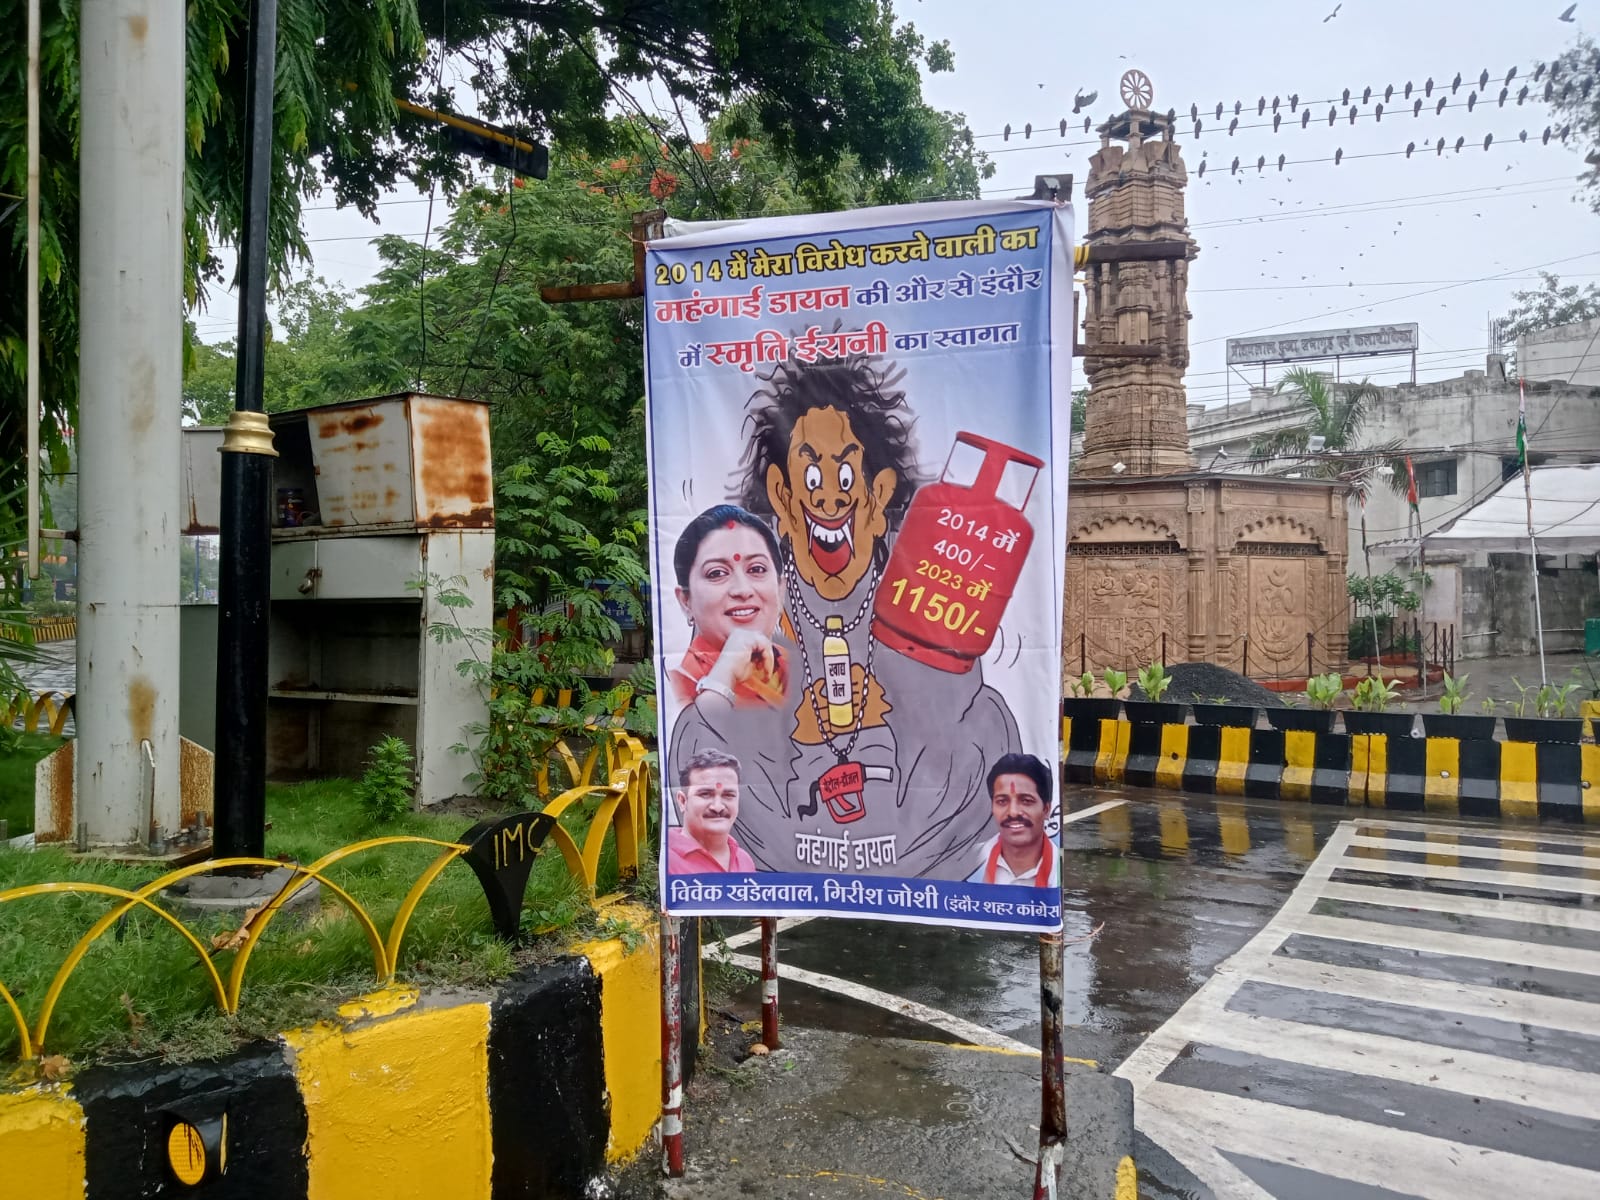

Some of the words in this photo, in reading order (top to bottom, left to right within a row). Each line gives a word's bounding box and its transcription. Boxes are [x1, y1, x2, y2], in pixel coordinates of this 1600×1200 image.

[655, 261, 722, 286] 2014
[728, 249, 748, 279] में
[751, 247, 793, 277] मेरा
[795, 239, 867, 273] विरोध
[870, 229, 930, 265] करने
[934, 224, 996, 258] वाली
[1000, 226, 1040, 251] का
[655, 286, 764, 323] महंगाई
[768, 286, 850, 314] डायन
[856, 280, 890, 306] की
[950, 271, 975, 297] से
[980, 265, 1041, 295] इंदौर
[678, 343, 702, 368] में
[705, 329, 789, 373] स्मृति
[795, 321, 888, 358] ईरानी
[894, 332, 928, 351] का
[933, 323, 1020, 348] स्वागत
[936, 508, 990, 542] 2014
[992, 528, 1021, 554] में
[933, 539, 996, 572] 400/-
[916, 559, 962, 590] 2023
[966, 579, 993, 602] में
[892, 578, 987, 636] 1150/-
[828, 662, 846, 677] खाद्य
[832, 681, 846, 698] तेल
[494, 817, 542, 870] IMC
[795, 828, 850, 871] महंगाई
[850, 833, 898, 871] डायन
[671, 879, 723, 903] विवेक
[726, 878, 819, 904] खंडेलवाल,
[823, 878, 883, 905] गिरीश
[888, 882, 939, 909] जोशी
[944, 894, 980, 914] (इंदौर
[982, 902, 1013, 916] शहर
